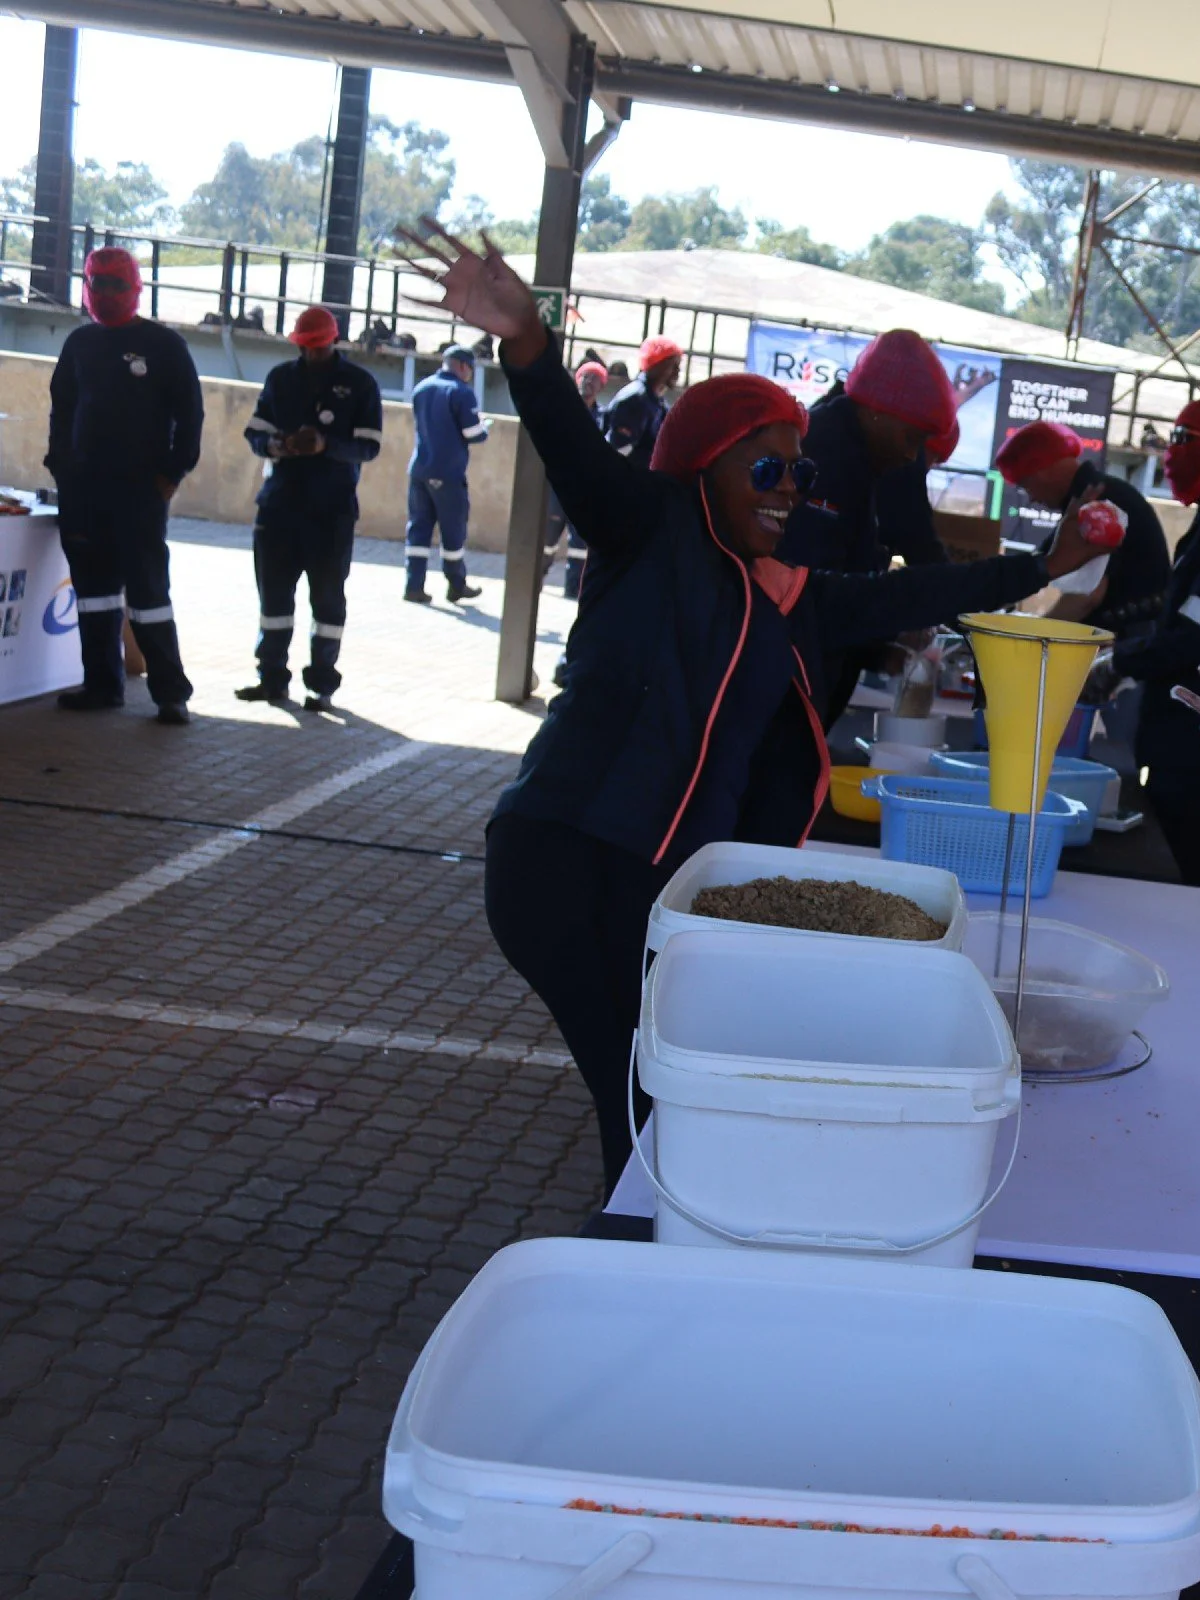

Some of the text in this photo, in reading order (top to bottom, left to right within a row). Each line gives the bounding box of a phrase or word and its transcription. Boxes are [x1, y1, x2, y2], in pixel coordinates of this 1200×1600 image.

[1009, 391, 1070, 412] WE CAN
[1011, 379, 1089, 402] TOGETHER
[1008, 404, 1106, 429] END HUNGER!
